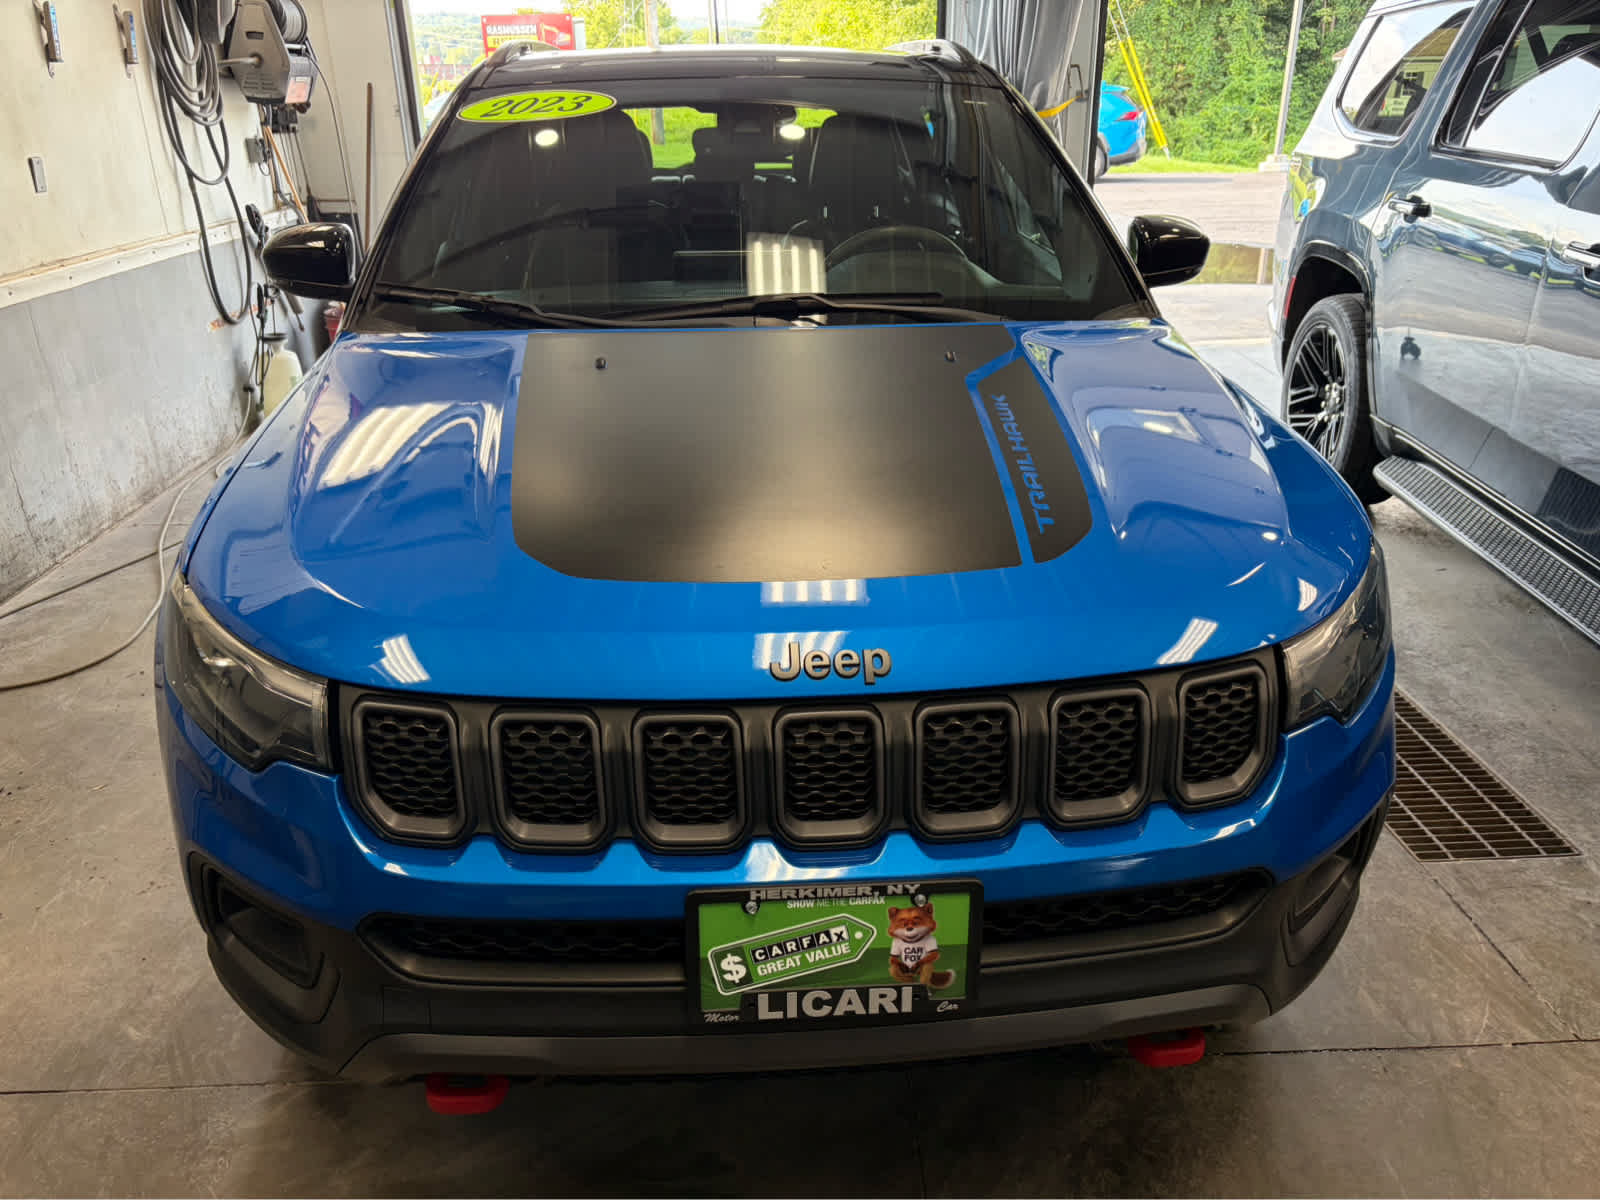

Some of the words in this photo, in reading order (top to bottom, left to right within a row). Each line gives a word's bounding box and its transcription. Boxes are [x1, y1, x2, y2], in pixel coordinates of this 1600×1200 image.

[480, 96, 592, 118] 2023
[991, 394, 1055, 534] TRAILHAWK
[769, 641, 892, 685] Jeep
[887, 884, 920, 895] NY
[787, 899, 815, 909] SHOW
[816, 899, 830, 908] ME
[832, 898, 848, 907] THE
[848, 894, 886, 906] CARFAX
[752, 927, 849, 963] CARFAX
[904, 946, 924, 955] CAR
[757, 954, 801, 977] GREAT
[805, 943, 851, 963] VALUE
[757, 986, 913, 1020] LICARI
[936, 1000, 959, 1013] Car
[703, 1012, 740, 1023] Motor
